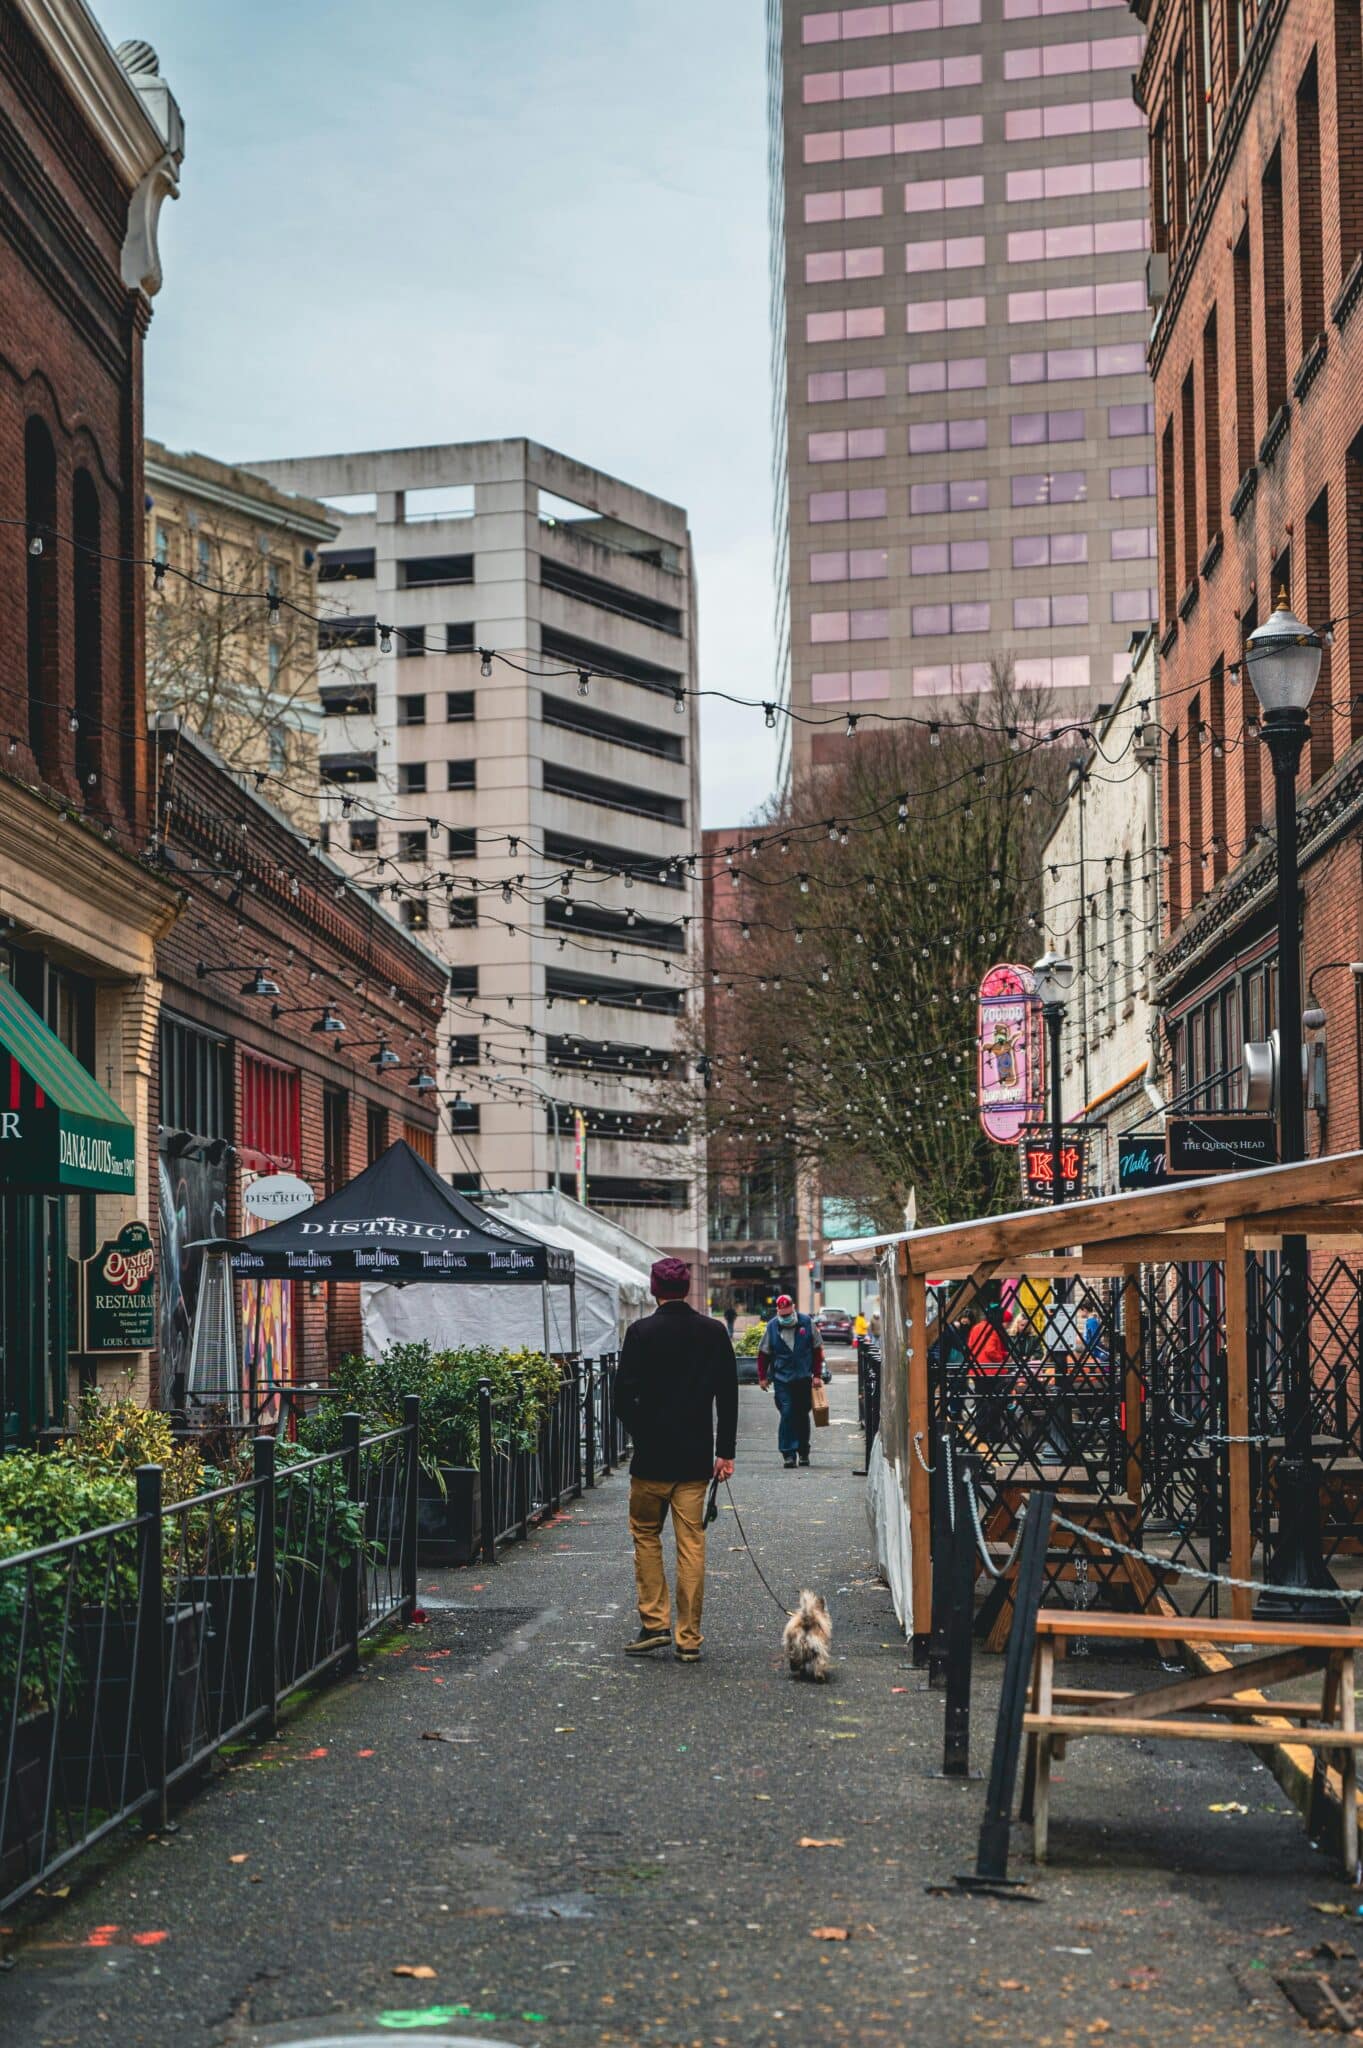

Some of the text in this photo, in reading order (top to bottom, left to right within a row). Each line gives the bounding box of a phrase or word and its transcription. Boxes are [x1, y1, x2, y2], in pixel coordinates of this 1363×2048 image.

[60, 1129, 79, 1168] DAN
[79, 1135, 87, 1168] &
[87, 1137, 112, 1173] LOUIS
[112, 1156, 123, 1175] Since
[1183, 1141, 1265, 1151] THE QUEEN'S HEAD
[1120, 1149, 1151, 1177] Nails
[1036, 1181, 1075, 1191] CLB
[245, 1193, 314, 1203] DISTRICT
[300, 1221, 471, 1239] DISTRICT
[103, 1249, 153, 1282] Oyster
[240, 1252, 264, 1267] Olives
[286, 1249, 332, 1267] Three Olives
[353, 1247, 400, 1267] Three Olives
[420, 1250, 467, 1268] Three Olives
[488, 1251, 510, 1268] Three
[510, 1249, 534, 1268] Olives
[122, 1264, 149, 1292] Bar
[103, 1338, 122, 1346] LOUIS
